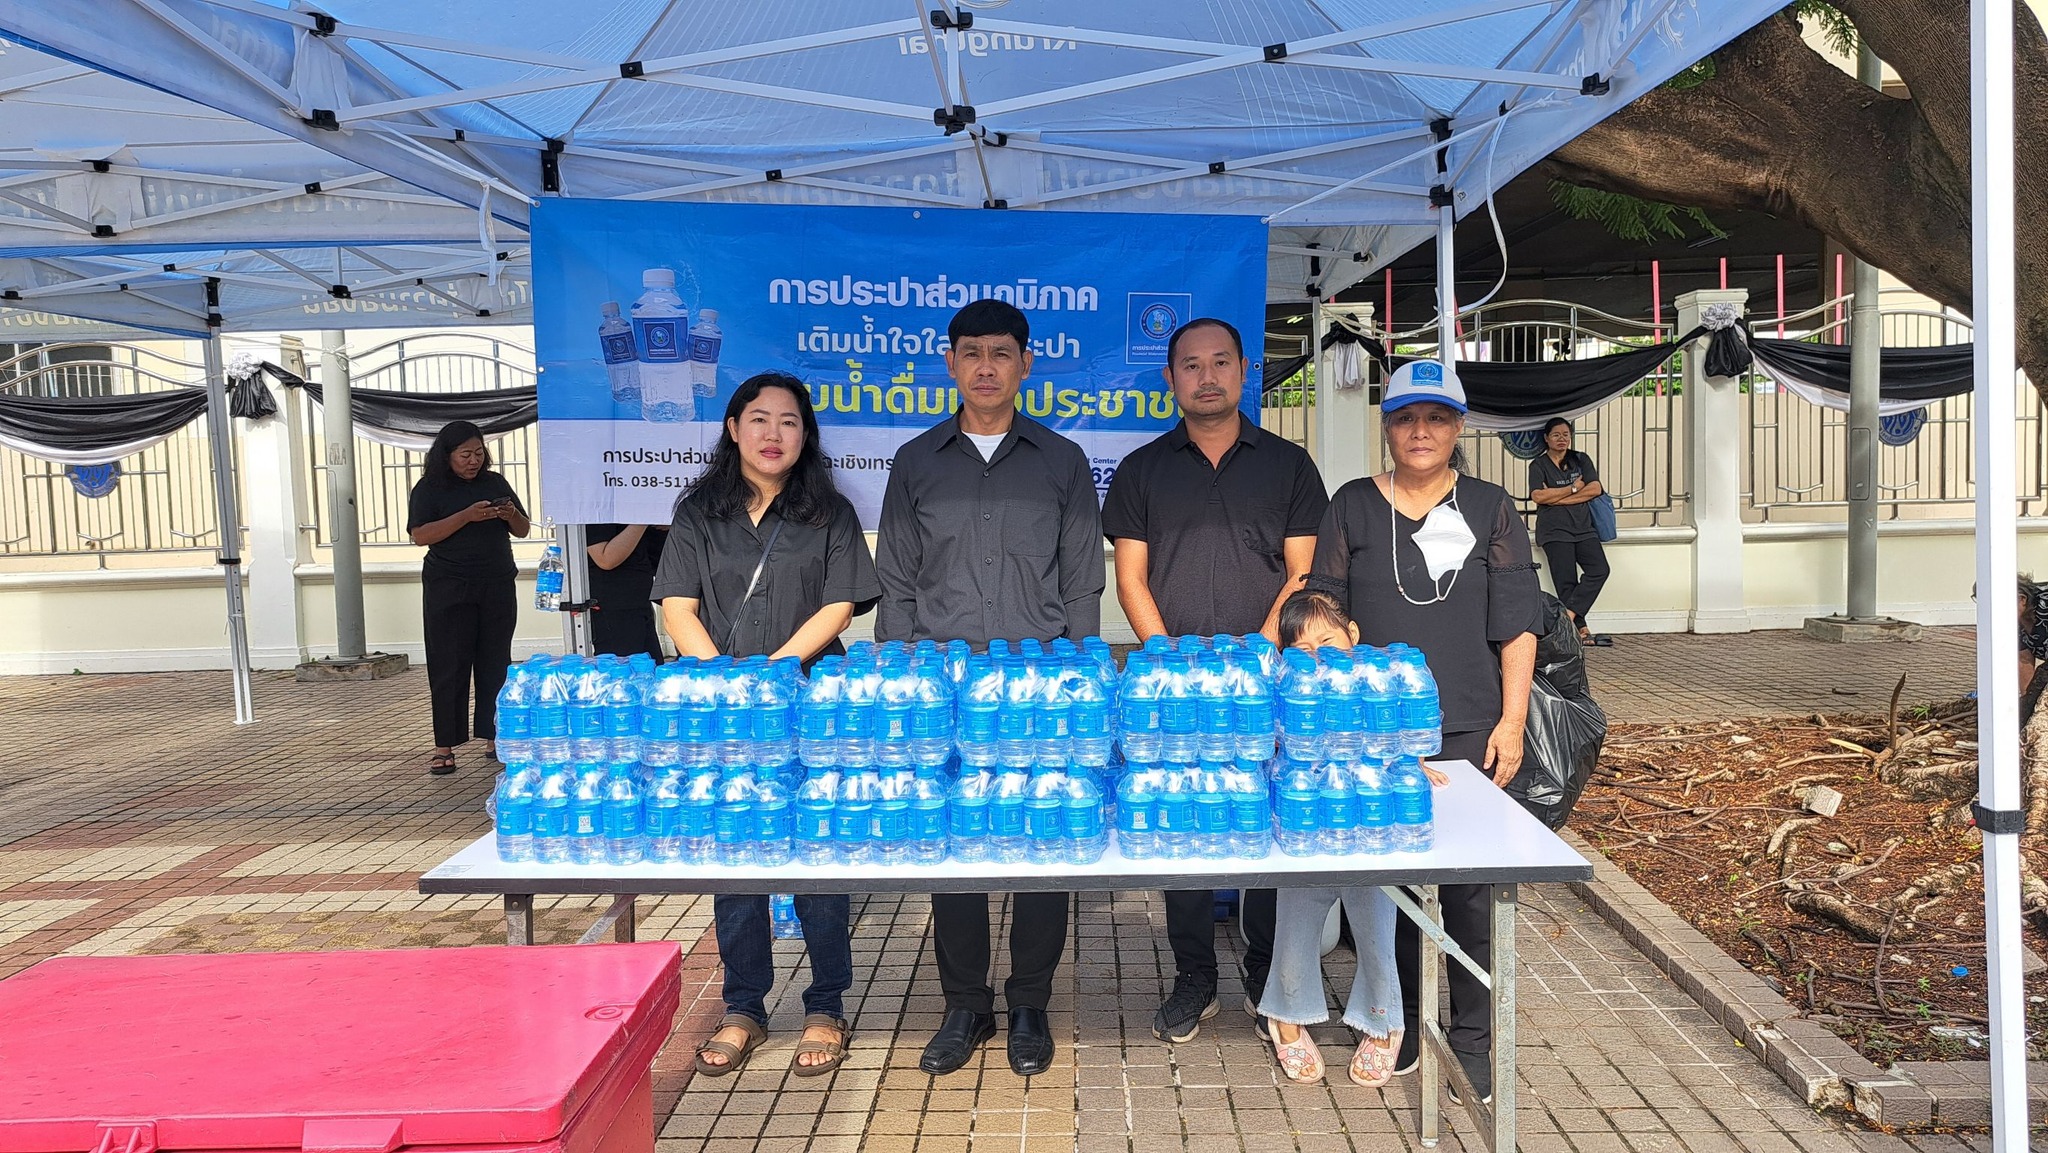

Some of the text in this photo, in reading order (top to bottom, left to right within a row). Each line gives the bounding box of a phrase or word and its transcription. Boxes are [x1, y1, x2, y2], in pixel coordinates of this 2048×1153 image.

[769, 274, 1098, 312] การประปาส่วนภมิภาค
[603, 472, 628, 487] โทร.
